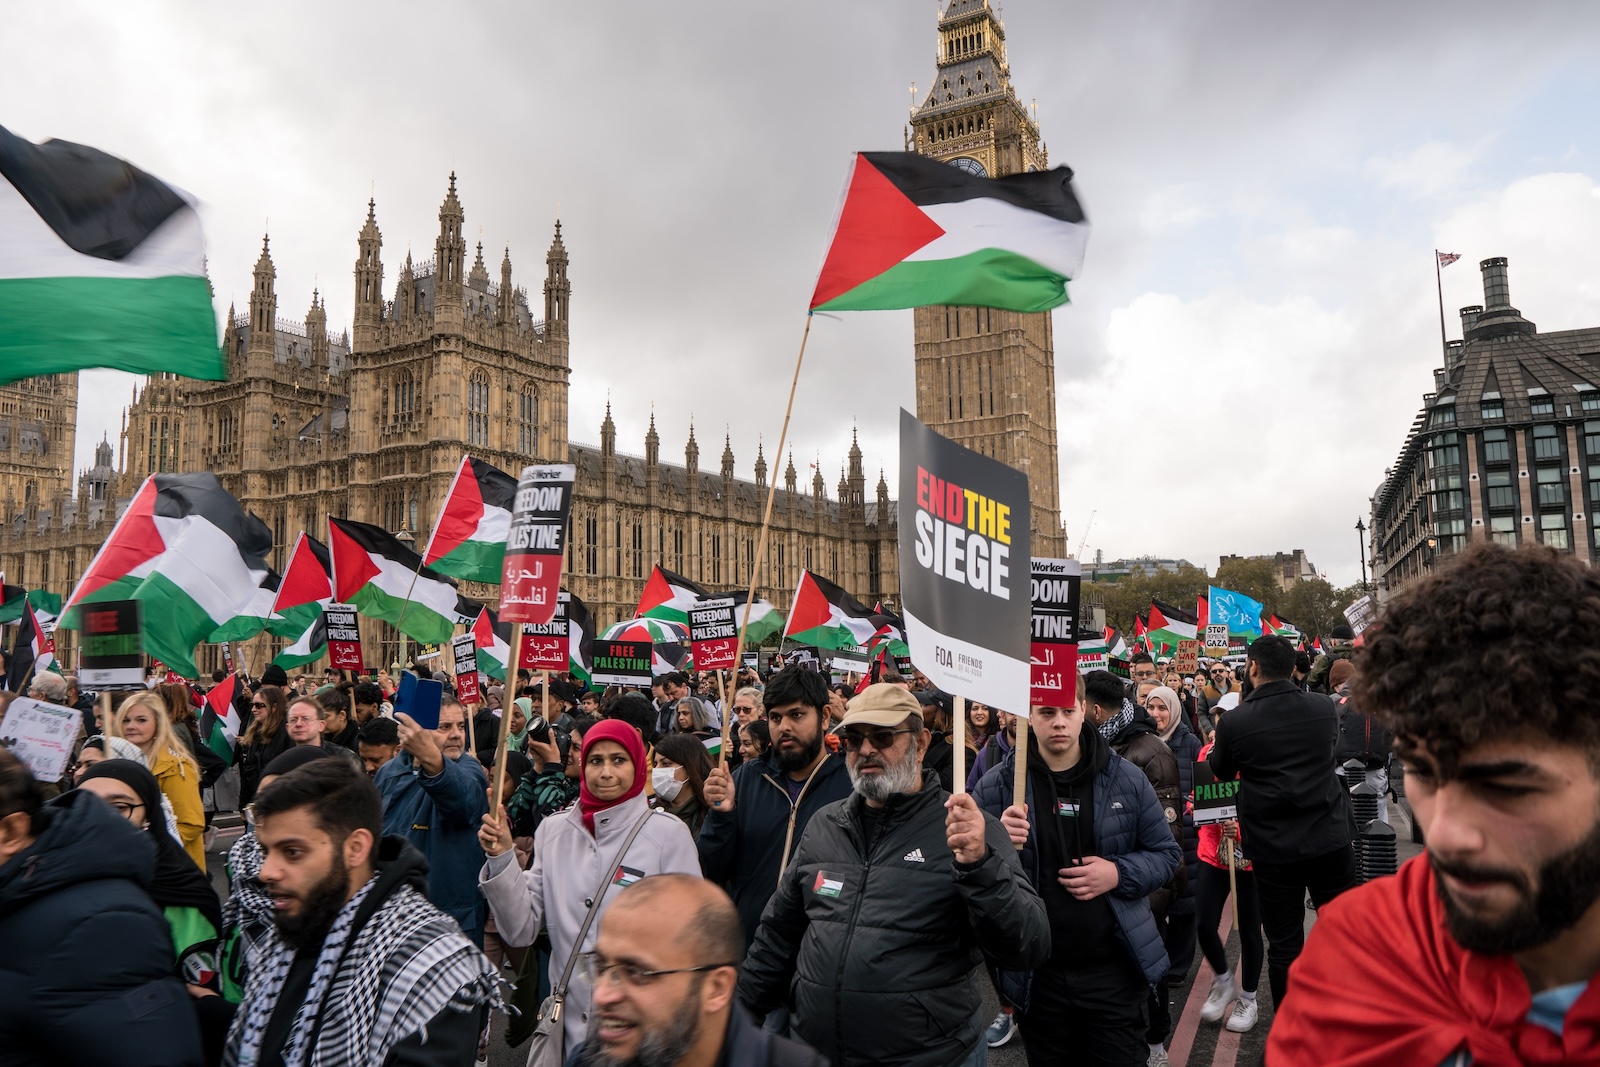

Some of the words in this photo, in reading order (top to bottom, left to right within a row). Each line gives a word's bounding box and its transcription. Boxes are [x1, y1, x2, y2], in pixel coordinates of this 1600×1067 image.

[917, 465, 964, 525] END
[964, 488, 1011, 545] THE
[915, 508, 1010, 600] SIEGE
[506, 561, 542, 584] الحرية
[1031, 561, 1065, 573] Worker
[327, 613, 355, 624] FREEDOM
[692, 608, 731, 624] FREEDOM
[522, 622, 567, 635] PALESTINE
[692, 625, 736, 640] PALESTINE
[1031, 615, 1072, 639] TINE
[1207, 626, 1226, 634] STOP
[327, 629, 359, 641] PALESTINE
[335, 643, 355, 655] الحرية
[530, 639, 560, 652] الحرية
[610, 645, 635, 657] FREE
[701, 641, 730, 654] الحرية
[1179, 641, 1197, 649] STOP
[526, 652, 564, 662] لفلسطين
[699, 651, 736, 666] لفلسطين
[936, 645, 953, 669] FOA
[958, 653, 982, 670] FRIENDS
[1178, 652, 1196, 660] WAR
[594, 656, 650, 670] PALESTINE
[1176, 664, 1195, 672] GAZA
[1195, 781, 1240, 801] PALEST
[903, 855, 926, 863] adidas
